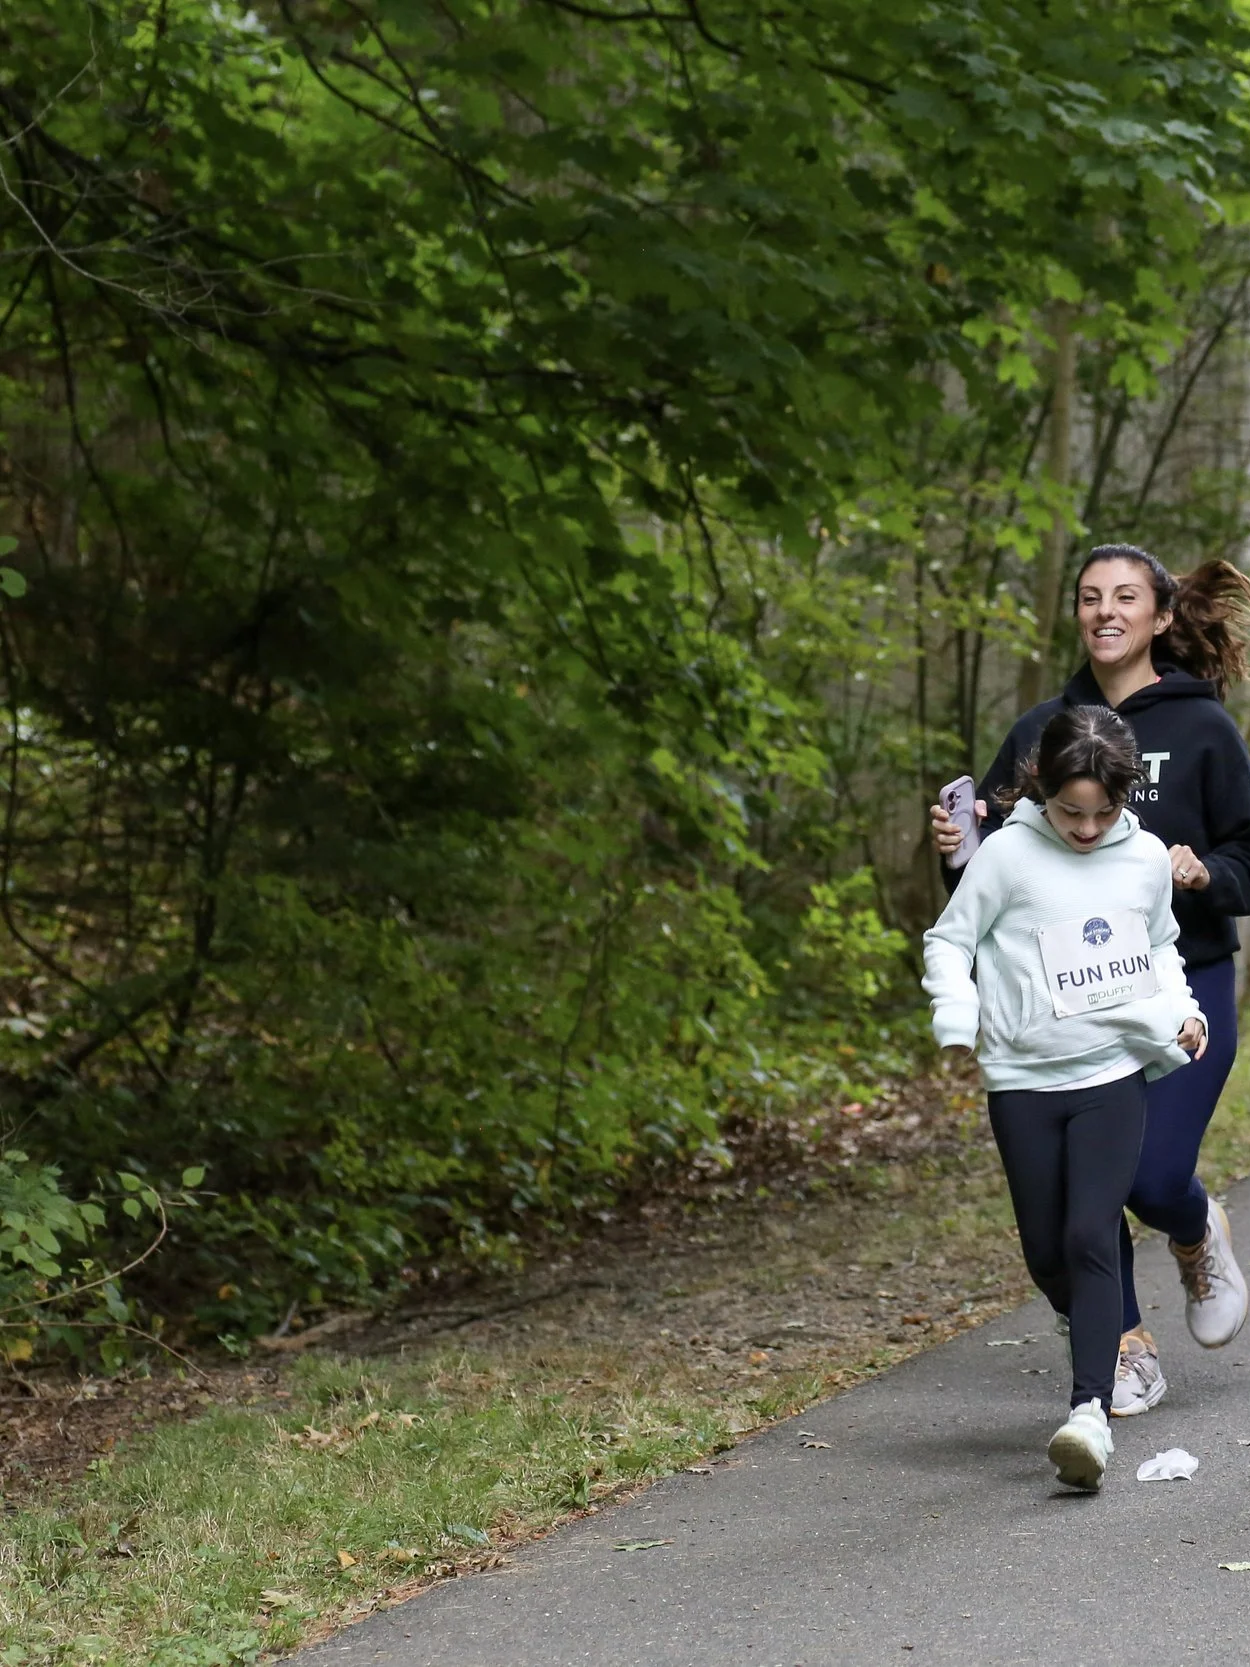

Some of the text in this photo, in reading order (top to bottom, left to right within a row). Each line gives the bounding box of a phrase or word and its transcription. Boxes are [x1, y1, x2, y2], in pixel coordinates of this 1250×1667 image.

[1056, 953, 1150, 991] FUN RUN
[1098, 984, 1134, 1000] DUFFY
